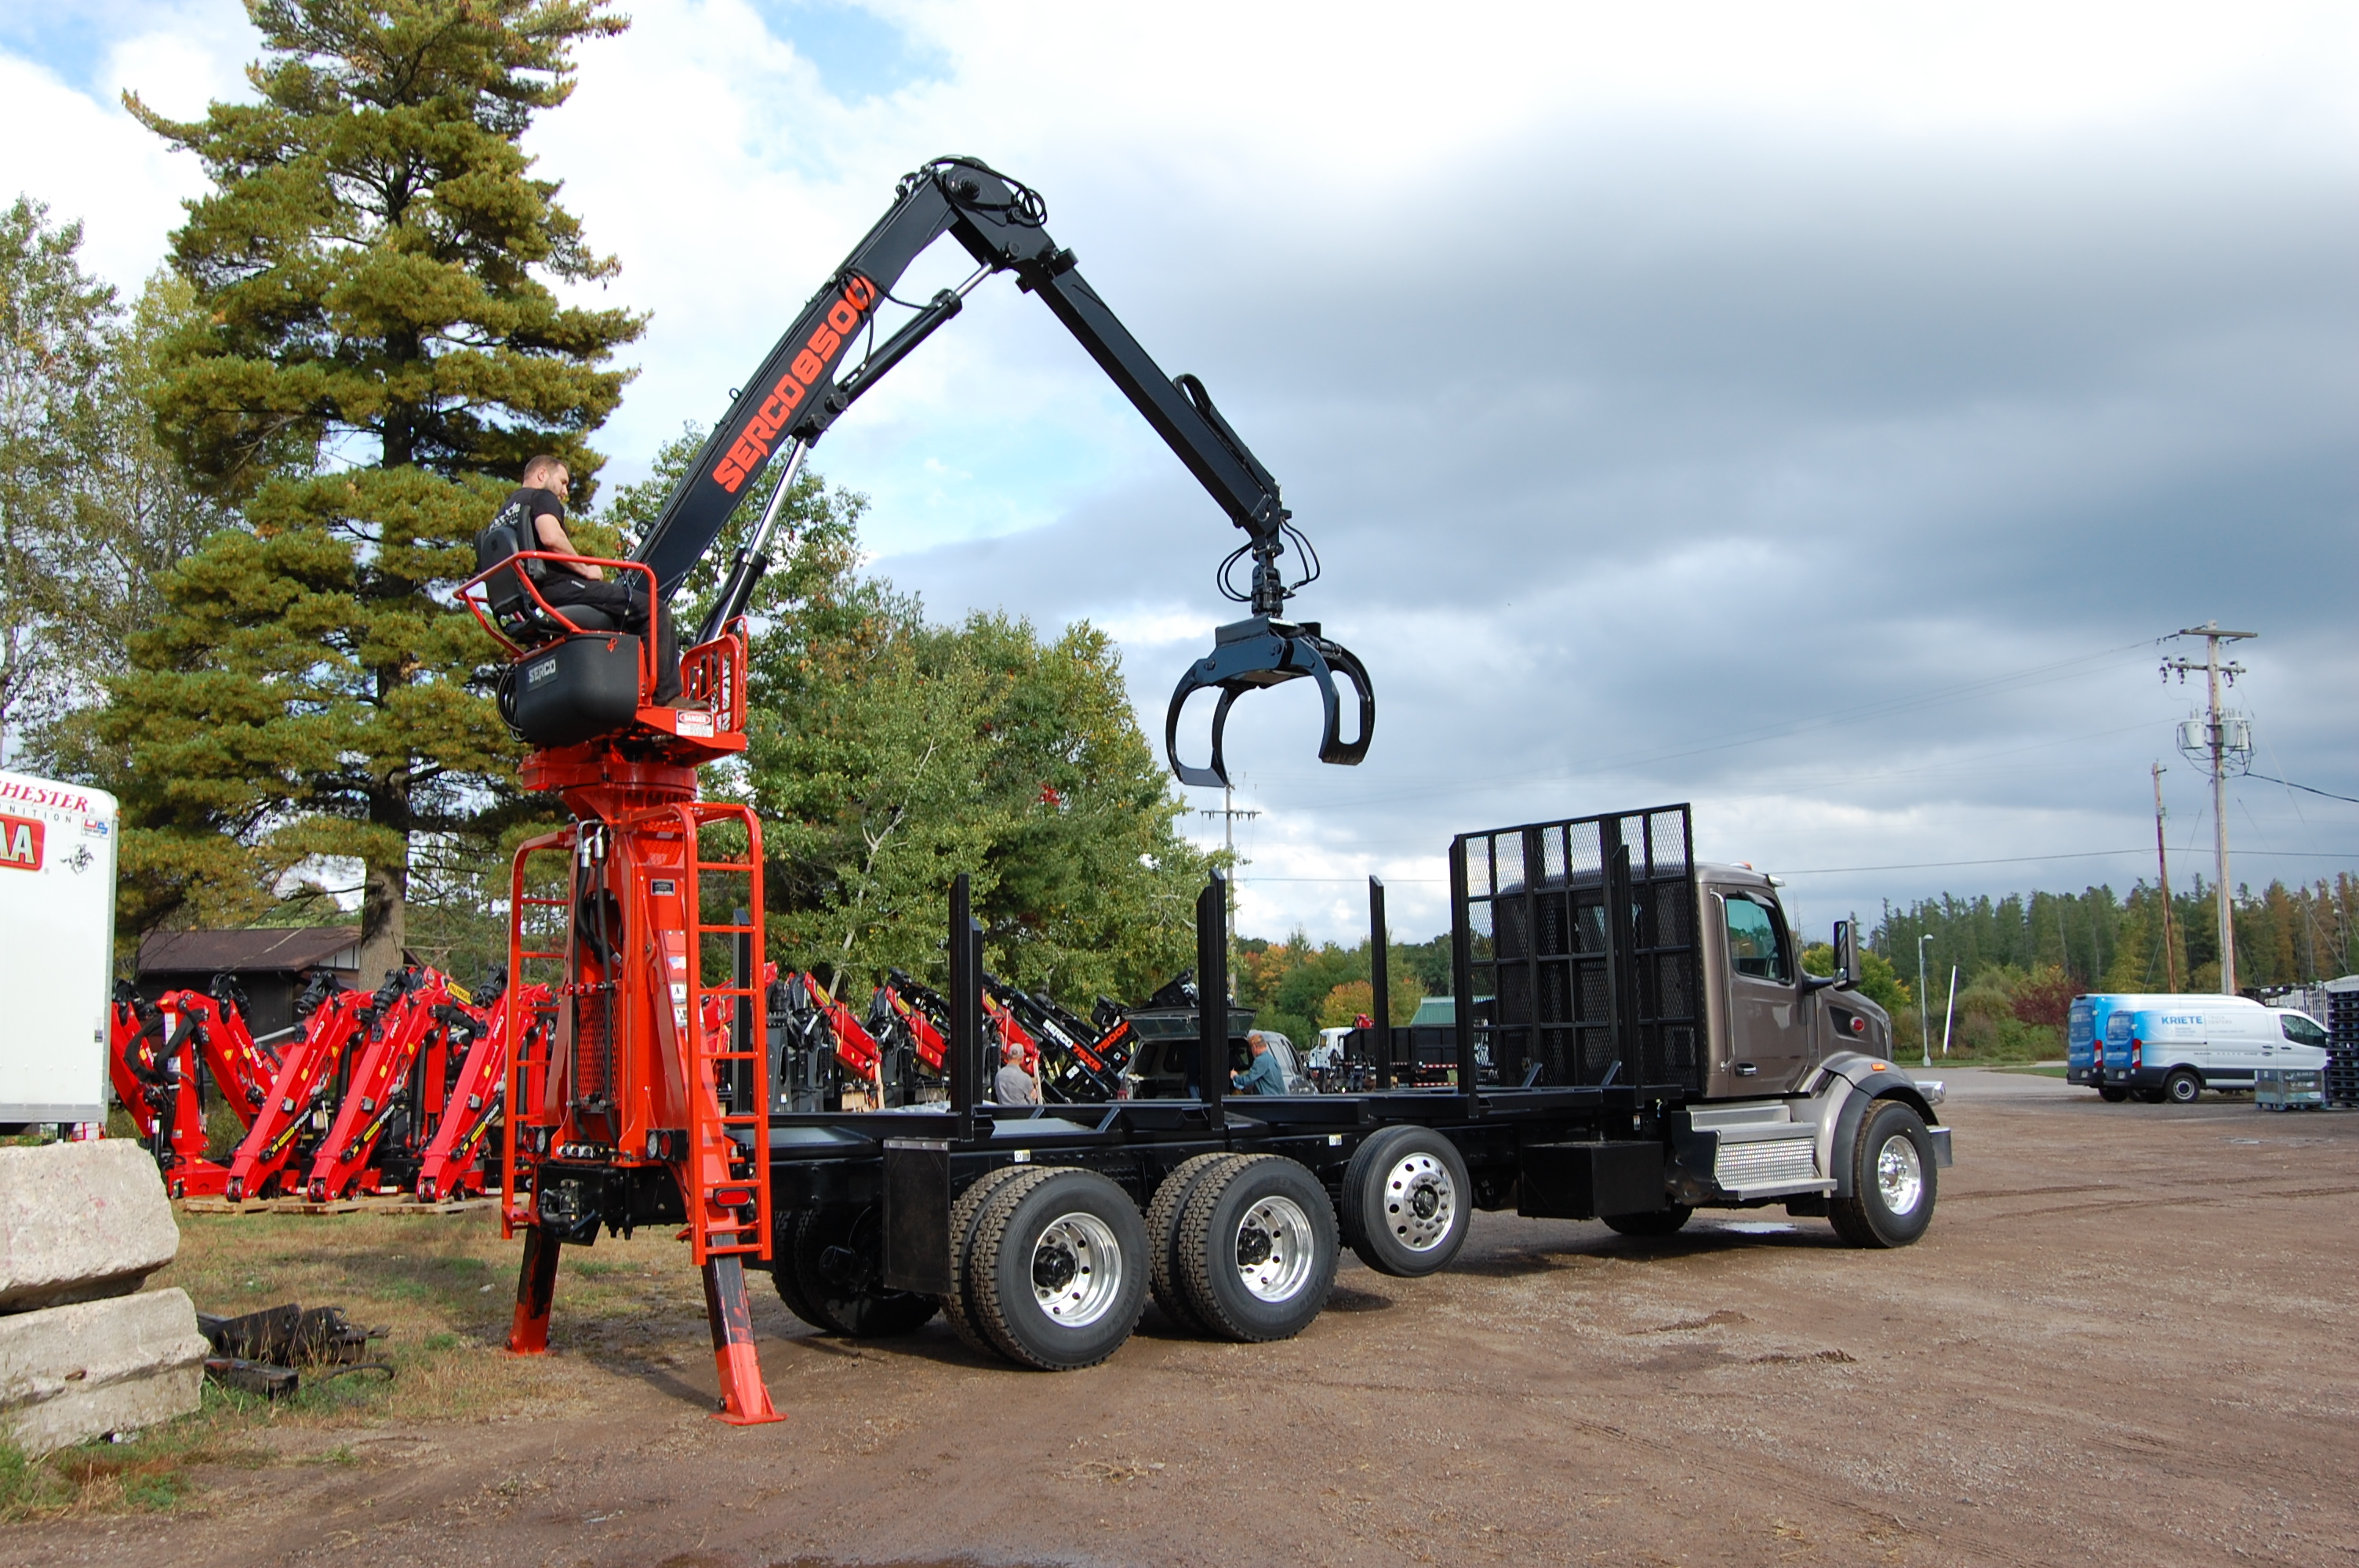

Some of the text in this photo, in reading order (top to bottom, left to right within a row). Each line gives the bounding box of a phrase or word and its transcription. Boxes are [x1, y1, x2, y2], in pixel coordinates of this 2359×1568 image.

[528, 658, 556, 684] SERCO
[0, 780, 89, 813] HESTER
[0, 803, 71, 824] NITION
[2161, 1015, 2204, 1025] KRIETE
[1042, 1018, 1074, 1049] SERCO
